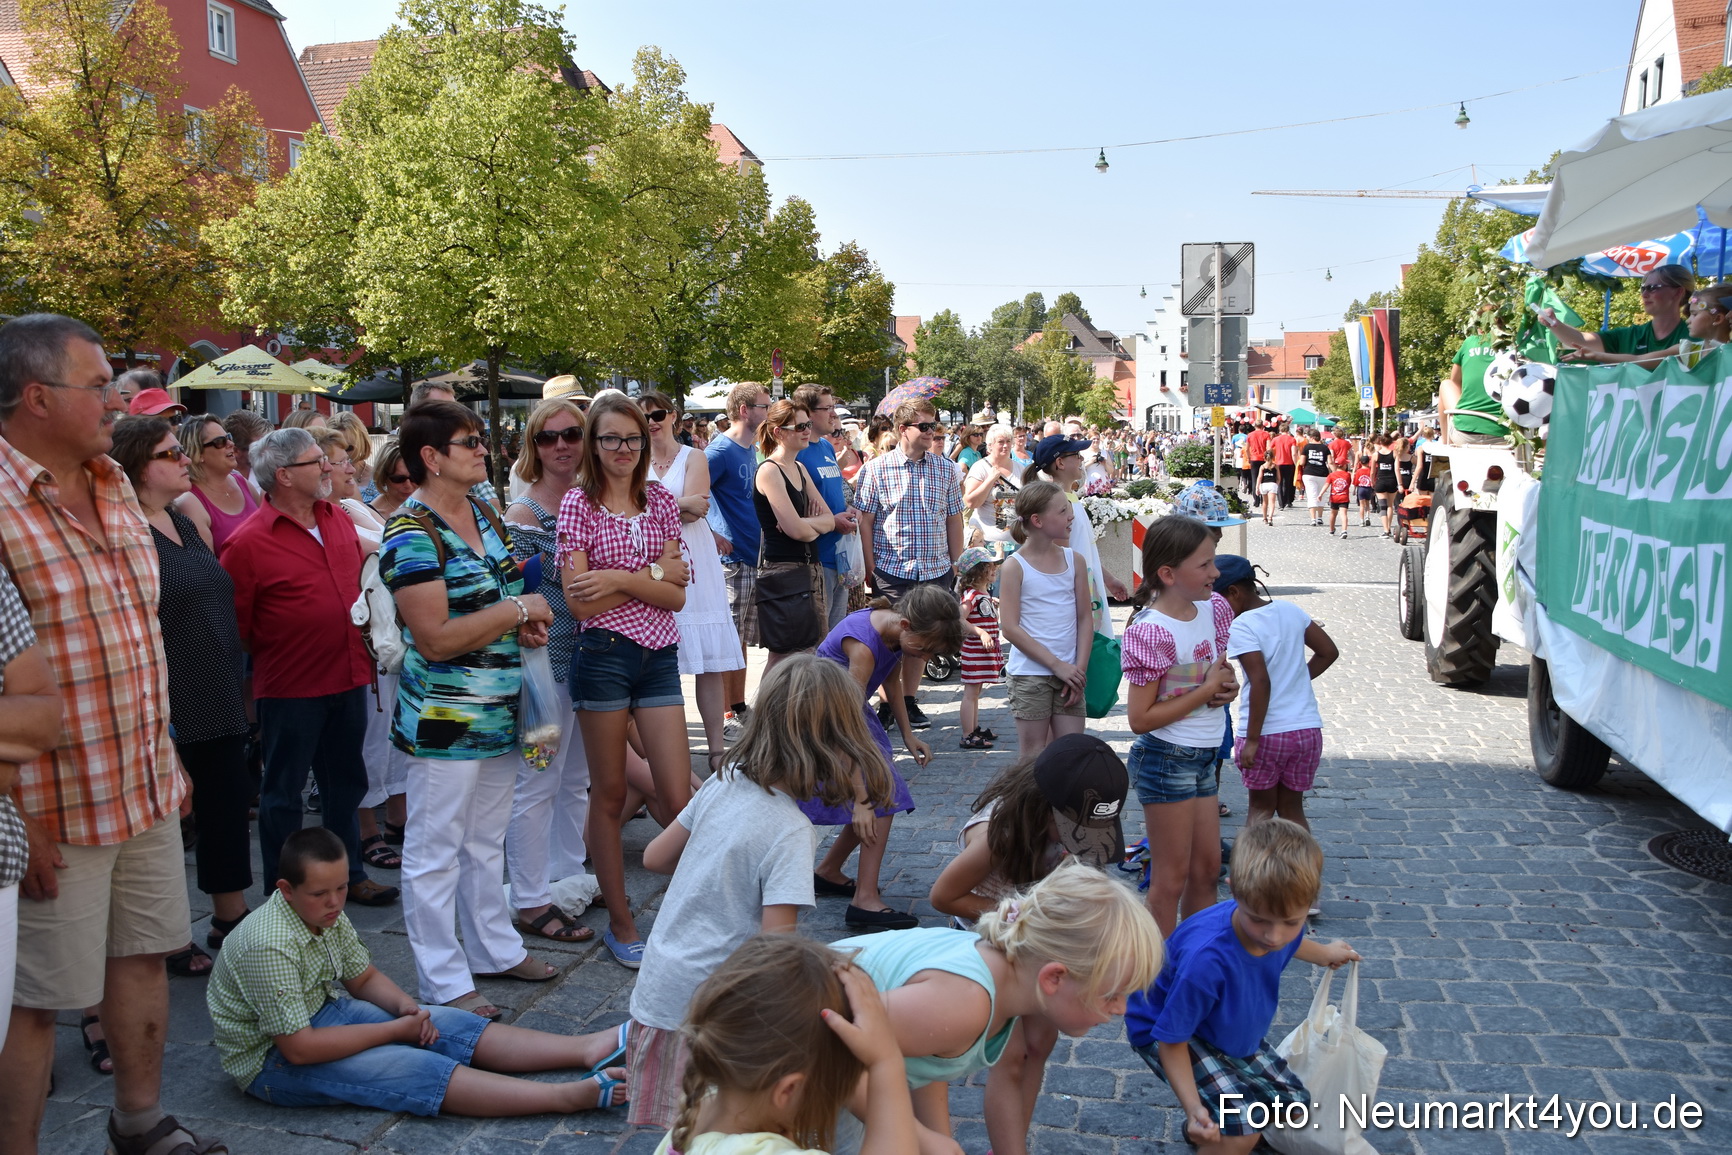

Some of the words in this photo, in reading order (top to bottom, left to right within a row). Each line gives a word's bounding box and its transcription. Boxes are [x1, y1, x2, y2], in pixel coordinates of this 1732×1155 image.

[1200, 296, 1236, 308] ZOE
[1469, 347, 1481, 357] SV
[216, 363, 275, 375] Glossner
[1363, 387, 1371, 398] P
[816, 465, 841, 479] PUMA
